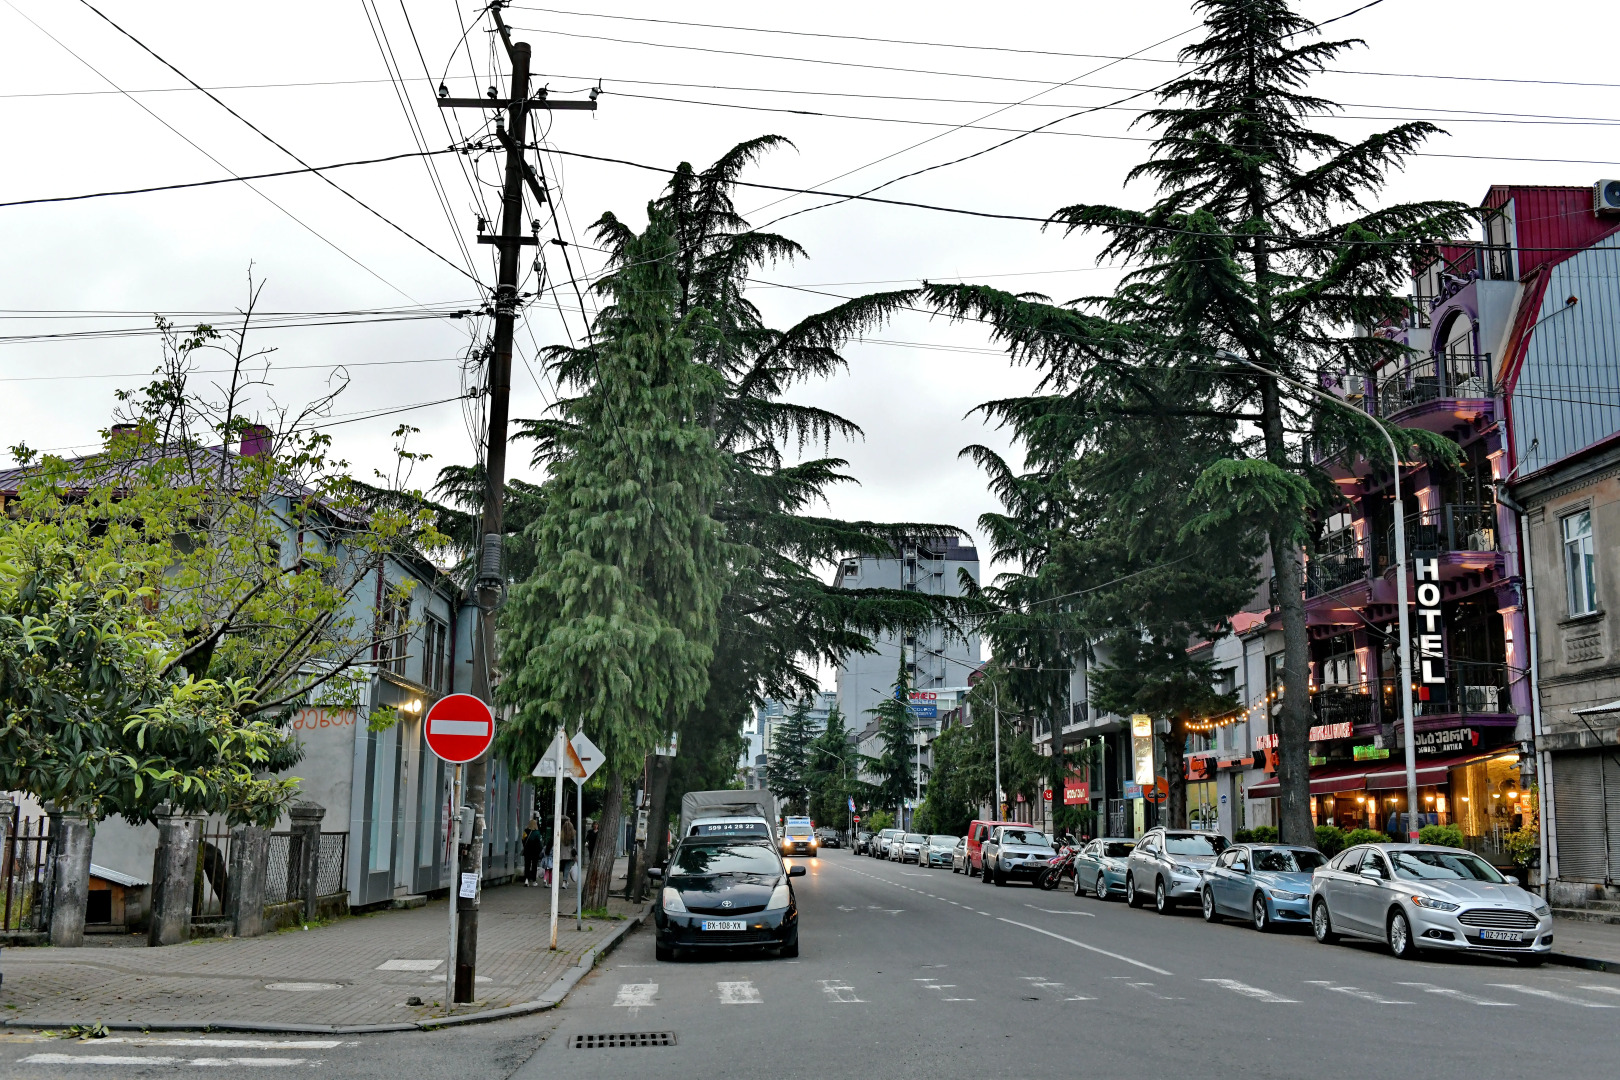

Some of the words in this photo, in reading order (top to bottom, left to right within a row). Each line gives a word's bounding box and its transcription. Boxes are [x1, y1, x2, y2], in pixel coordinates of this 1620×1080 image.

[1415, 558, 1446, 683] HOTEL
[1443, 743, 1463, 751] ANTIKA
[707, 921, 741, 930] BX-108-XX
